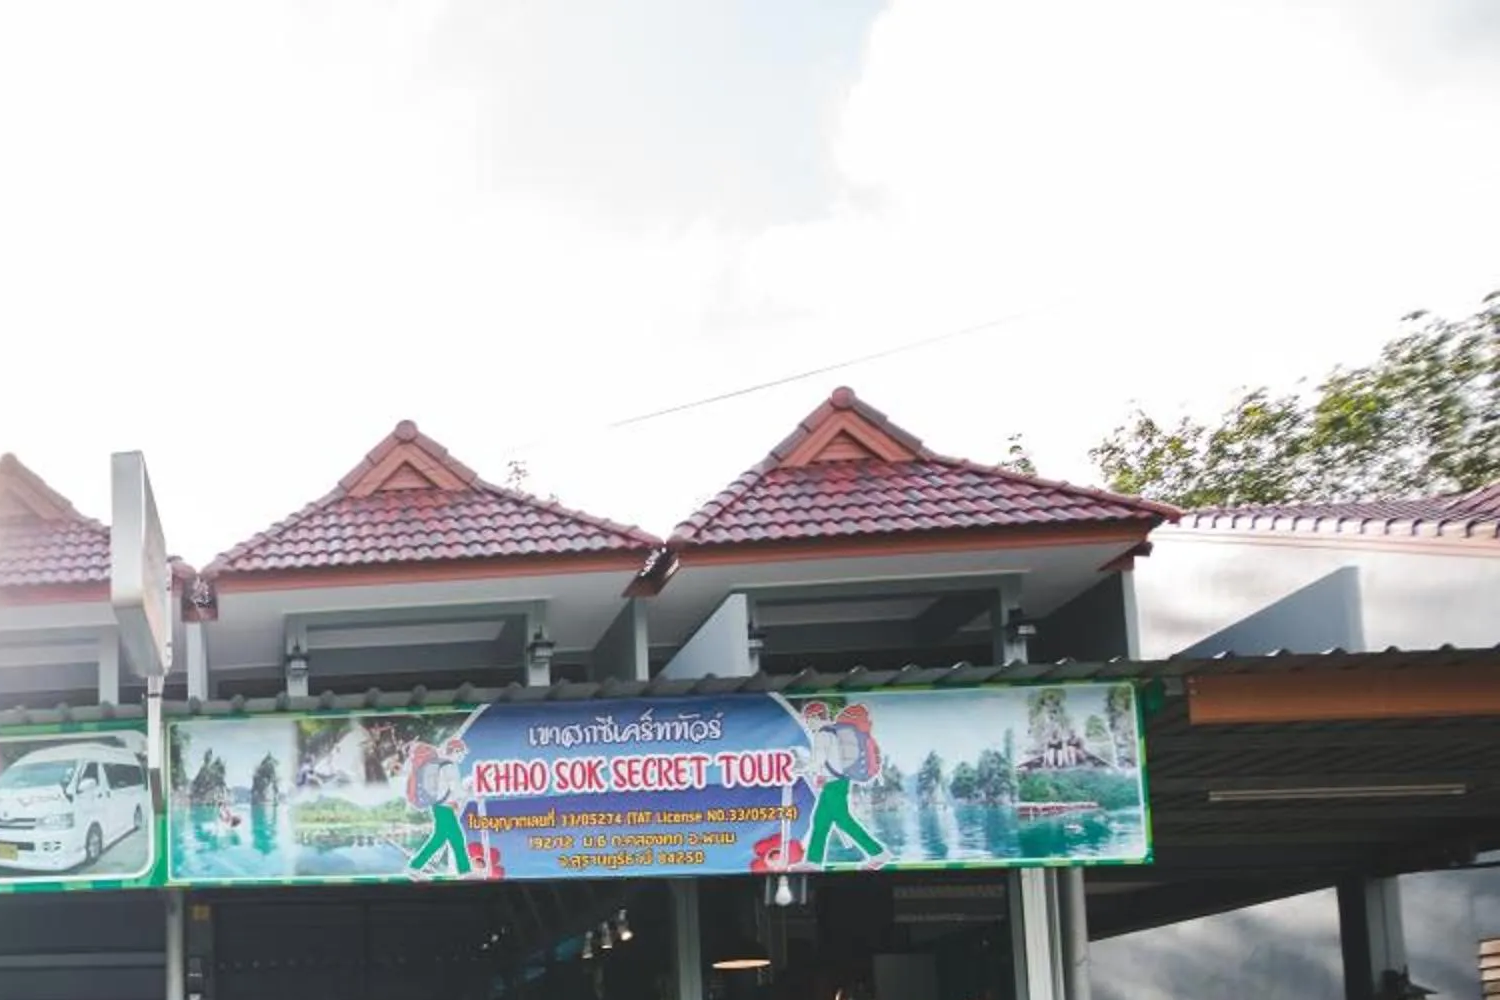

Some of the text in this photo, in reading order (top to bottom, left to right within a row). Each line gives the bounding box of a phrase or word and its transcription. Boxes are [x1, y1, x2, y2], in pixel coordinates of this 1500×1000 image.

[474, 751, 794, 794] KHAO SOK SECRET TOUR
